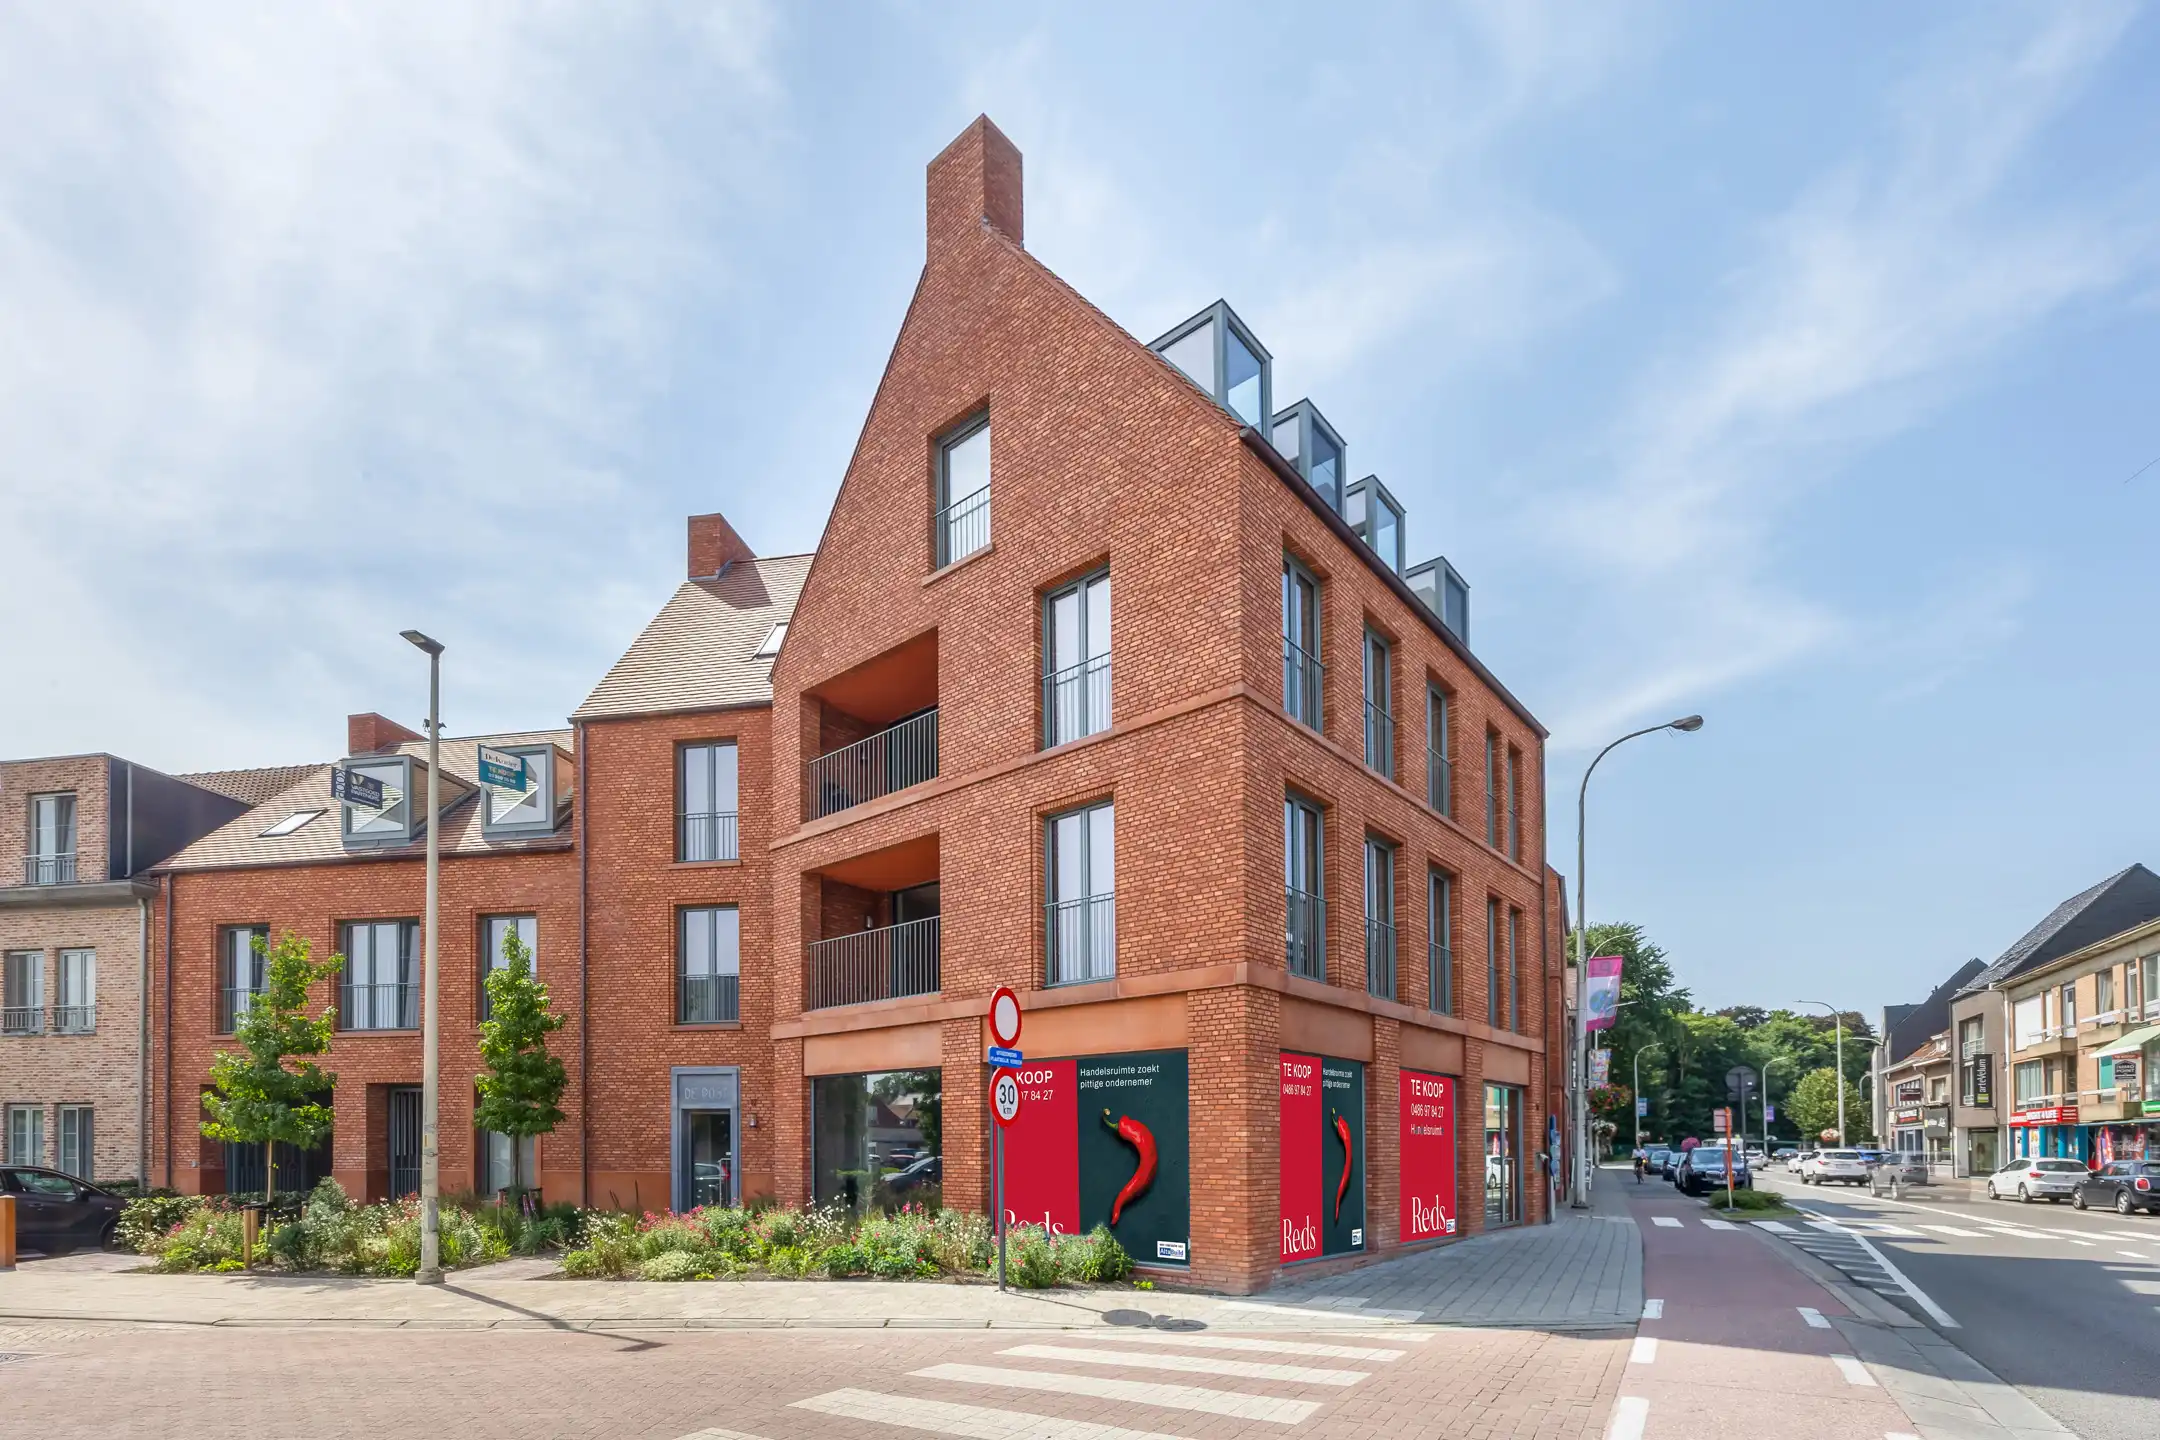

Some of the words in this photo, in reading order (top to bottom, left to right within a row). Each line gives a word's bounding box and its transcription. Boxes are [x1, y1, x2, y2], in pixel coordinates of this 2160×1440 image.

[1016, 1070, 1053, 1085] KOOP
[1080, 1065, 1136, 1077] Handelsruimte
[1137, 1063, 1160, 1074] zoekt
[1282, 1062, 1292, 1077] TE
[1293, 1063, 1312, 1079] KOOP
[1080, 1078, 1104, 1090] pittige
[1105, 1078, 1153, 1088] ondernemer
[1282, 1083, 1294, 1095] 0486
[1294, 1084, 1300, 1095] 97
[1300, 1084, 1306, 1096] 84
[1306, 1085, 1312, 1096] 27
[1411, 1079, 1421, 1096] TE
[1422, 1080, 1444, 1099] KOOP
[684, 1087, 697, 1100] DE
[701, 1087, 728, 1100] POST
[999, 1084, 1015, 1105] 30
[1030, 1090, 1041, 1101] 84
[1042, 1090, 1054, 1101] 27
[1003, 1105, 1013, 1114] km
[1411, 1103, 1424, 1117] 0486
[1424, 1104, 1430, 1117] 97
[1431, 1105, 1438, 1118] 84
[1438, 1106, 1444, 1118] 27
[1412, 1194, 1446, 1234] Reds
[1282, 1214, 1316, 1255] Reds
